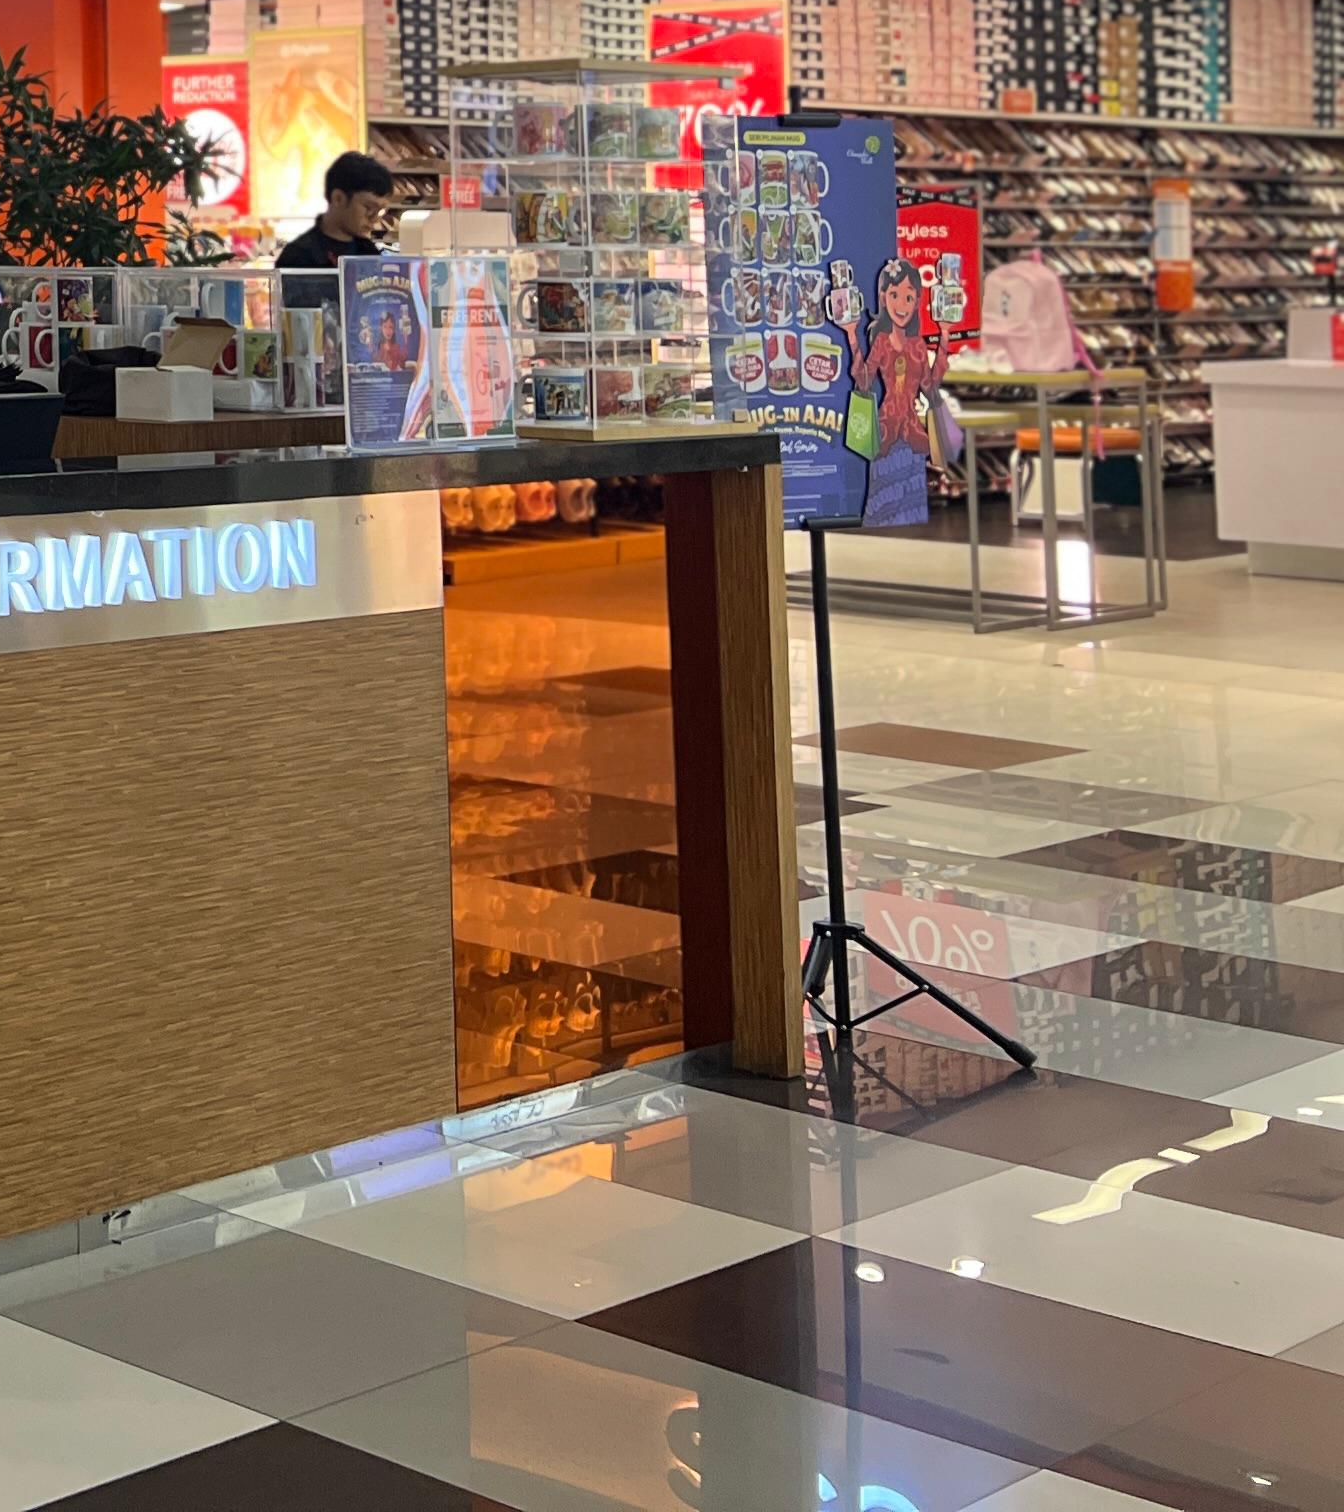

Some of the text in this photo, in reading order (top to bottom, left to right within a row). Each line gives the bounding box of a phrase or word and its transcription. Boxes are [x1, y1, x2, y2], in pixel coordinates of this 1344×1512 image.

[172, 75, 235, 91] FURTHER
[896, 224, 948, 241] ayless
[906, 247, 940, 259] UP TO
[747, 404, 844, 432] UG-IN AJA!
